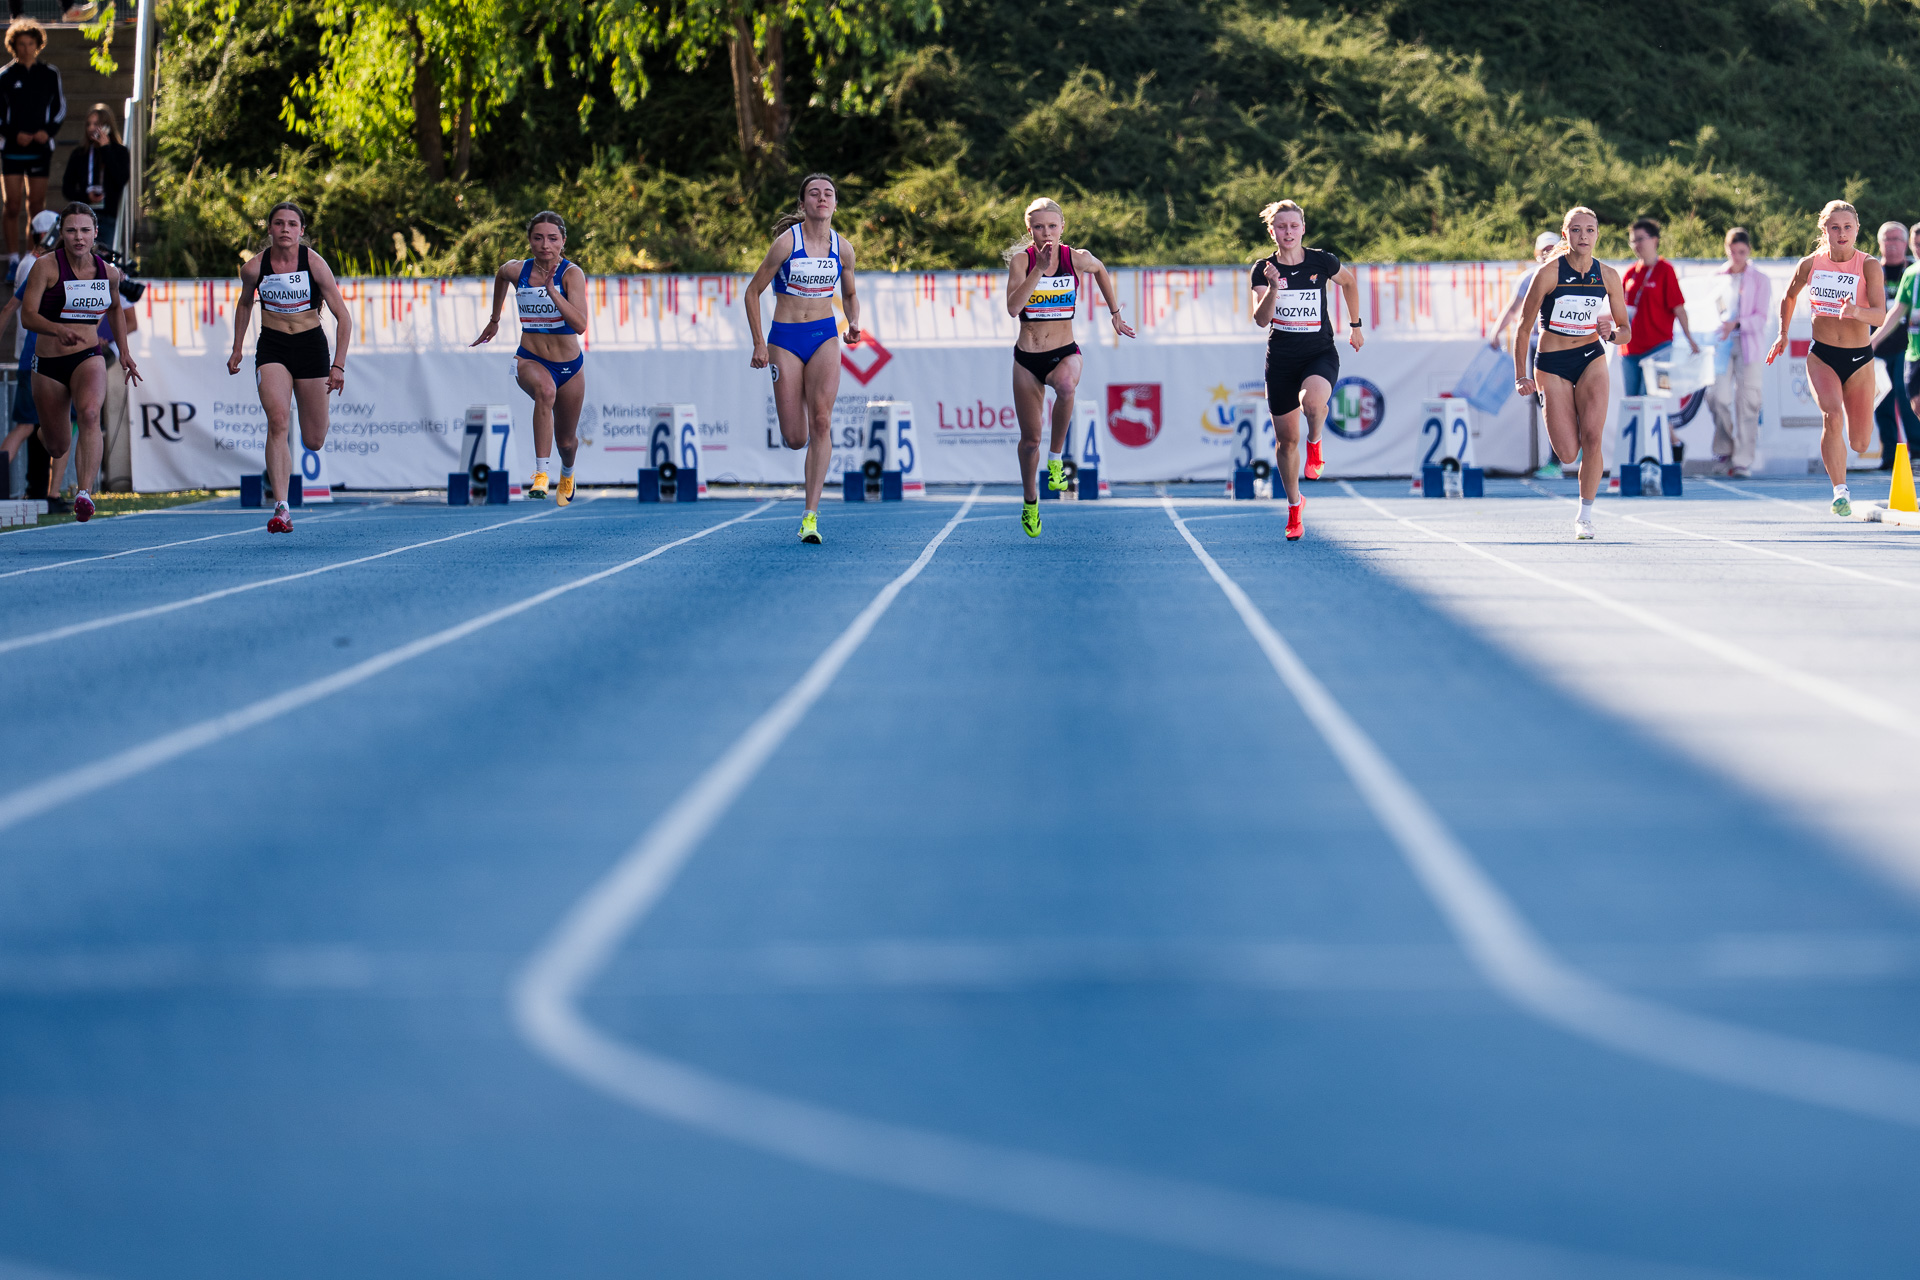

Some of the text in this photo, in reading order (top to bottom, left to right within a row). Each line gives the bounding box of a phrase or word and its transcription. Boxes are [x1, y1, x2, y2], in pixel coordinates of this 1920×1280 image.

[817, 260, 834, 269] 723
[90, 281, 106, 291] 488
[289, 274, 302, 284] 58
[790, 274, 836, 285] PASIERBEK
[1052, 278, 1071, 288] 617
[1837, 274, 1855, 285] 978
[262, 288, 309, 300] ROMANIUK
[1028, 294, 1073, 304] GONDEK
[1299, 291, 1317, 301] 721
[1810, 286, 1854, 301] GOLISZEWSKA
[72, 297, 105, 309] GRĘDA
[1584, 298, 1597, 307] 53
[1275, 306, 1318, 317] KOZYRA
[1559, 309, 1592, 322] LATOŃ
[1331, 396, 1376, 421] LUS
[139, 401, 198, 443] RP
[214, 436, 265, 451] Karola
[492, 424, 510, 470] 7
[651, 421, 671, 468] 6
[681, 422, 698, 469] 6
[868, 420, 887, 467] 5
[898, 420, 914, 474] 5
[1083, 420, 1101, 468] 4
[1235, 419, 1254, 469] 3
[1422, 418, 1443, 464] 2
[1452, 418, 1469, 464] 2
[1622, 415, 1638, 465] 1
[1651, 416, 1663, 464] 1
[466, 424, 484, 472] 7
